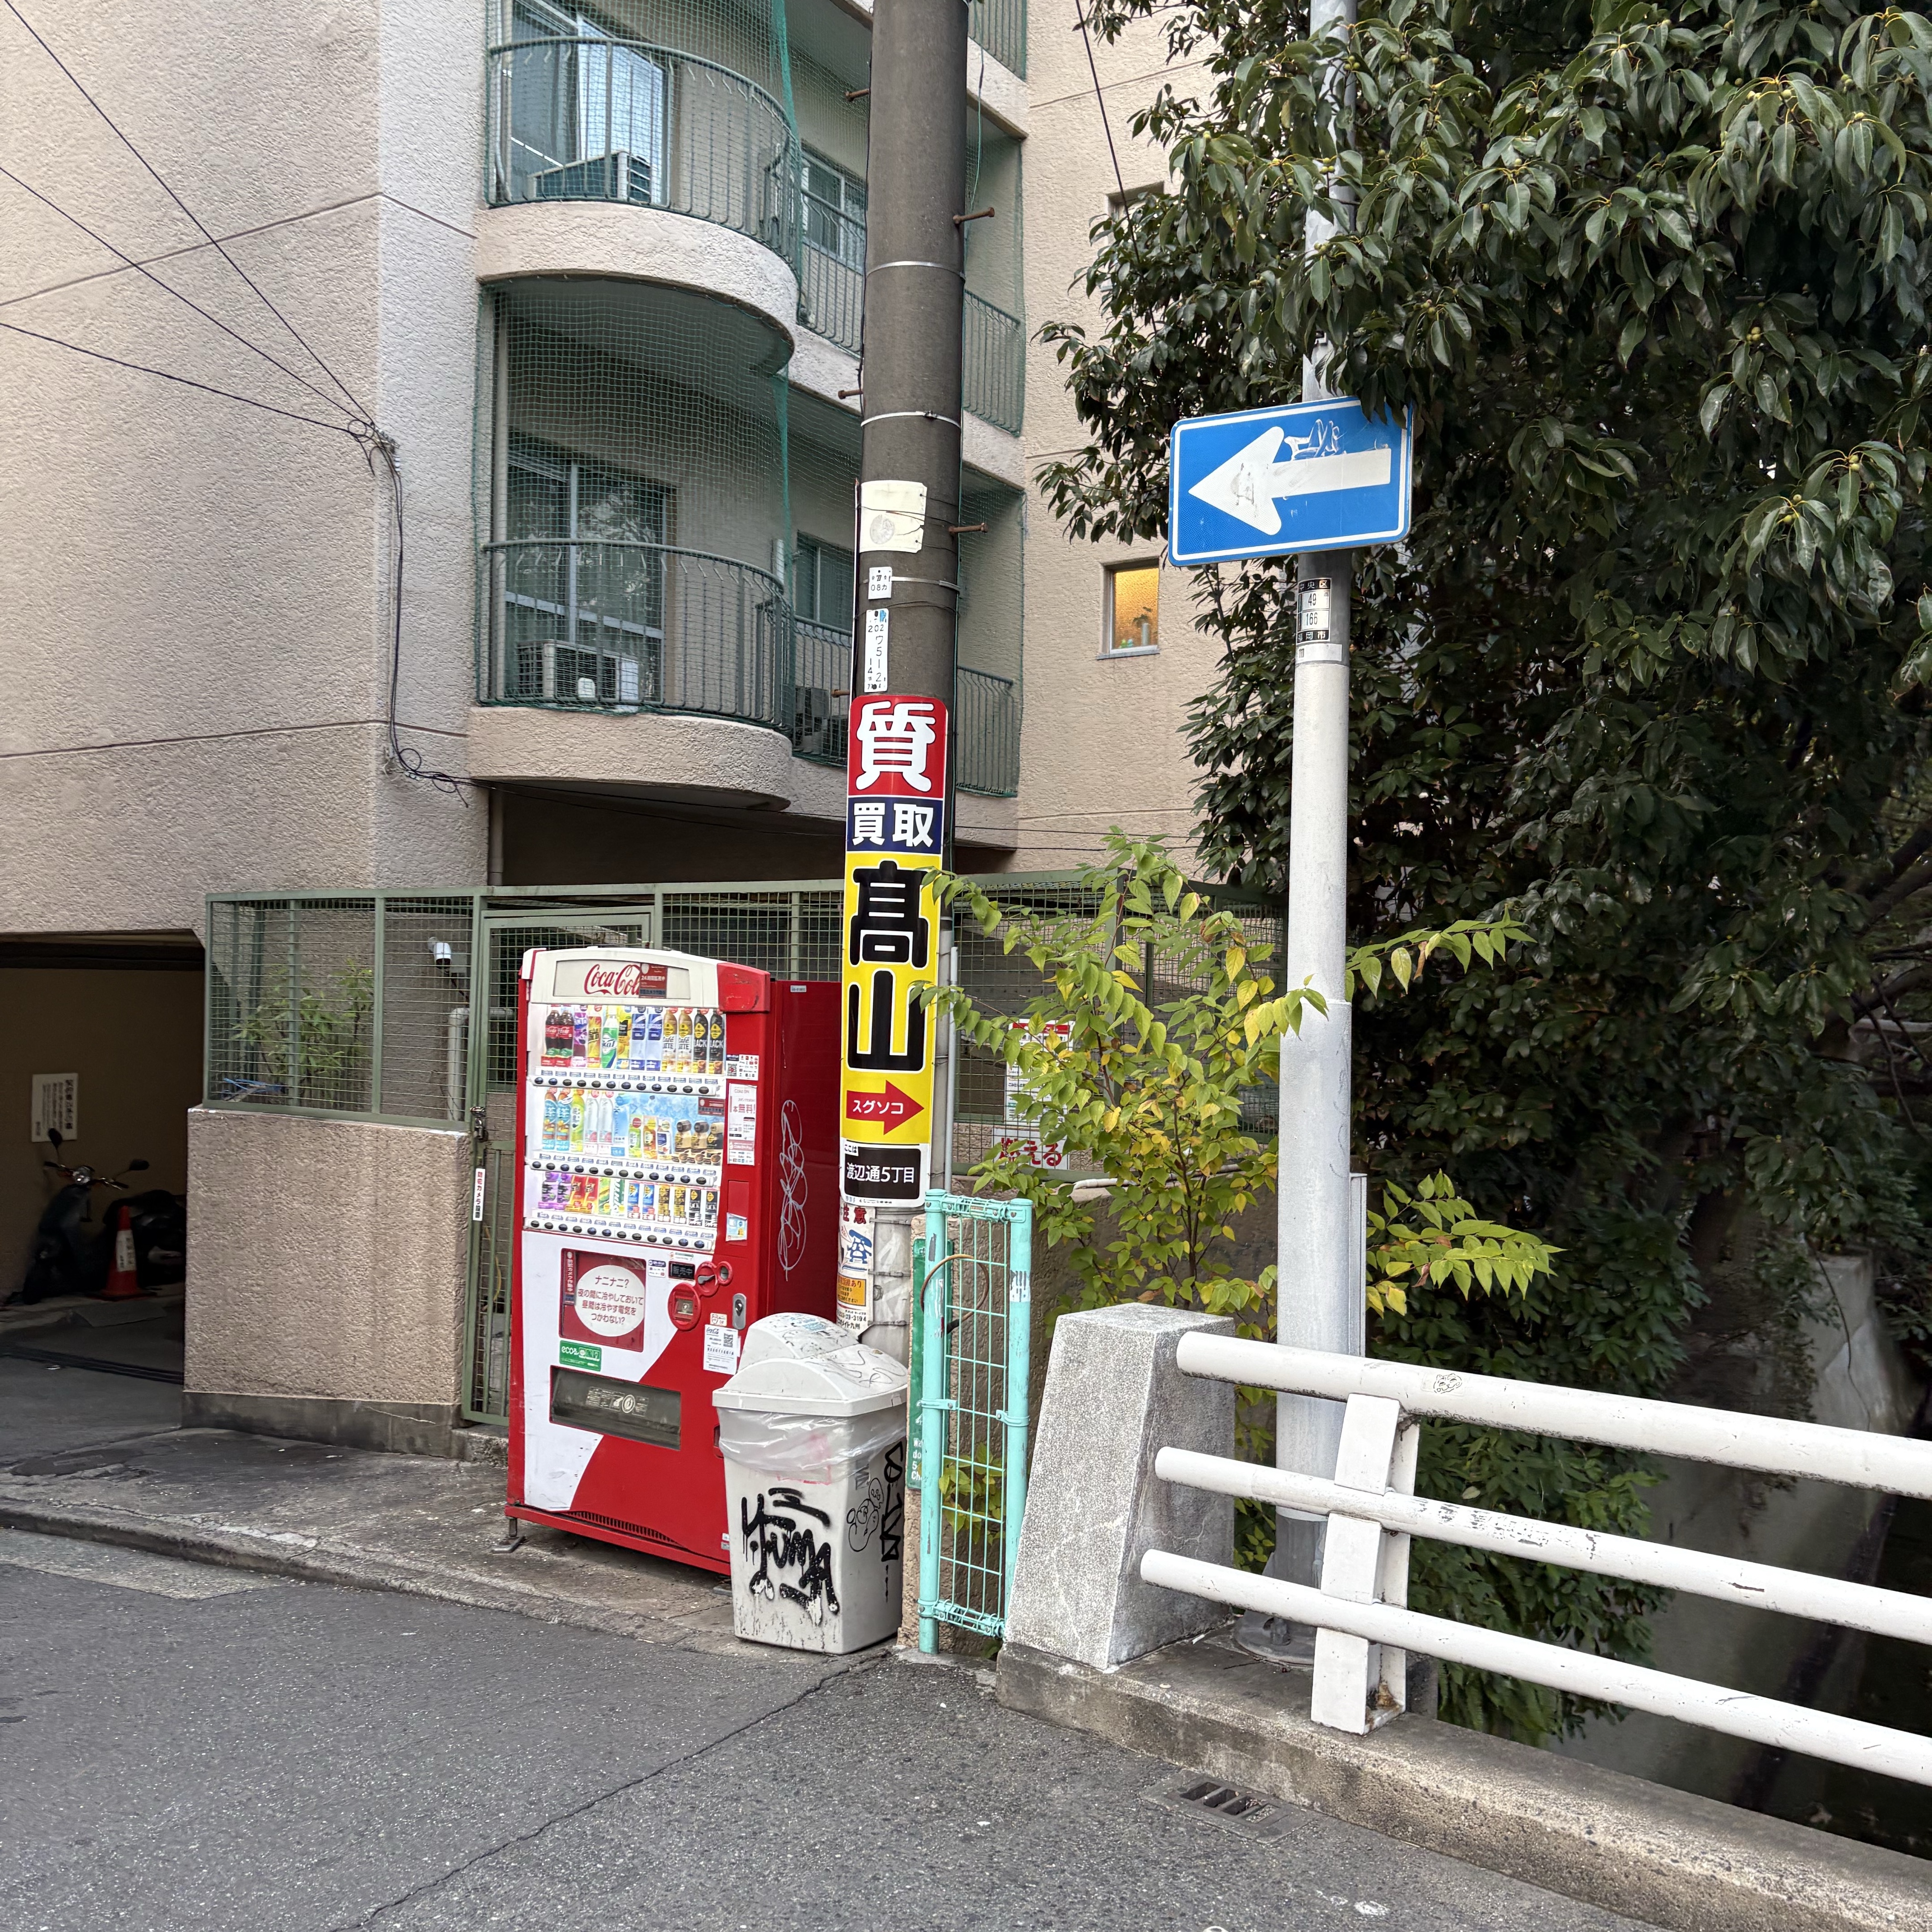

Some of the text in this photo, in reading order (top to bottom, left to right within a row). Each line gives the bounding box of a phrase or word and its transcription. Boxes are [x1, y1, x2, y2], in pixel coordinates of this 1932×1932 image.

[1308, 593, 1317, 607] 49
[1306, 612, 1318, 626] 166
[868, 624, 884, 633] 202
[856, 700, 936, 792] 質
[852, 802, 934, 848] 買取
[584, 964, 640, 995] Coca-Col
[694, 1039, 707, 1048] LACK
[710, 1040, 724, 1049] LACK
[852, 1100, 904, 1114] スグソコ
[844, 1144, 857, 1154] ここは
[846, 1162, 915, 1183] 渡辺通5丁目
[578, 1288, 644, 1306] 夜の間に冷やしておいて
[582, 1300, 637, 1316] 昼間は冷やす電気を
